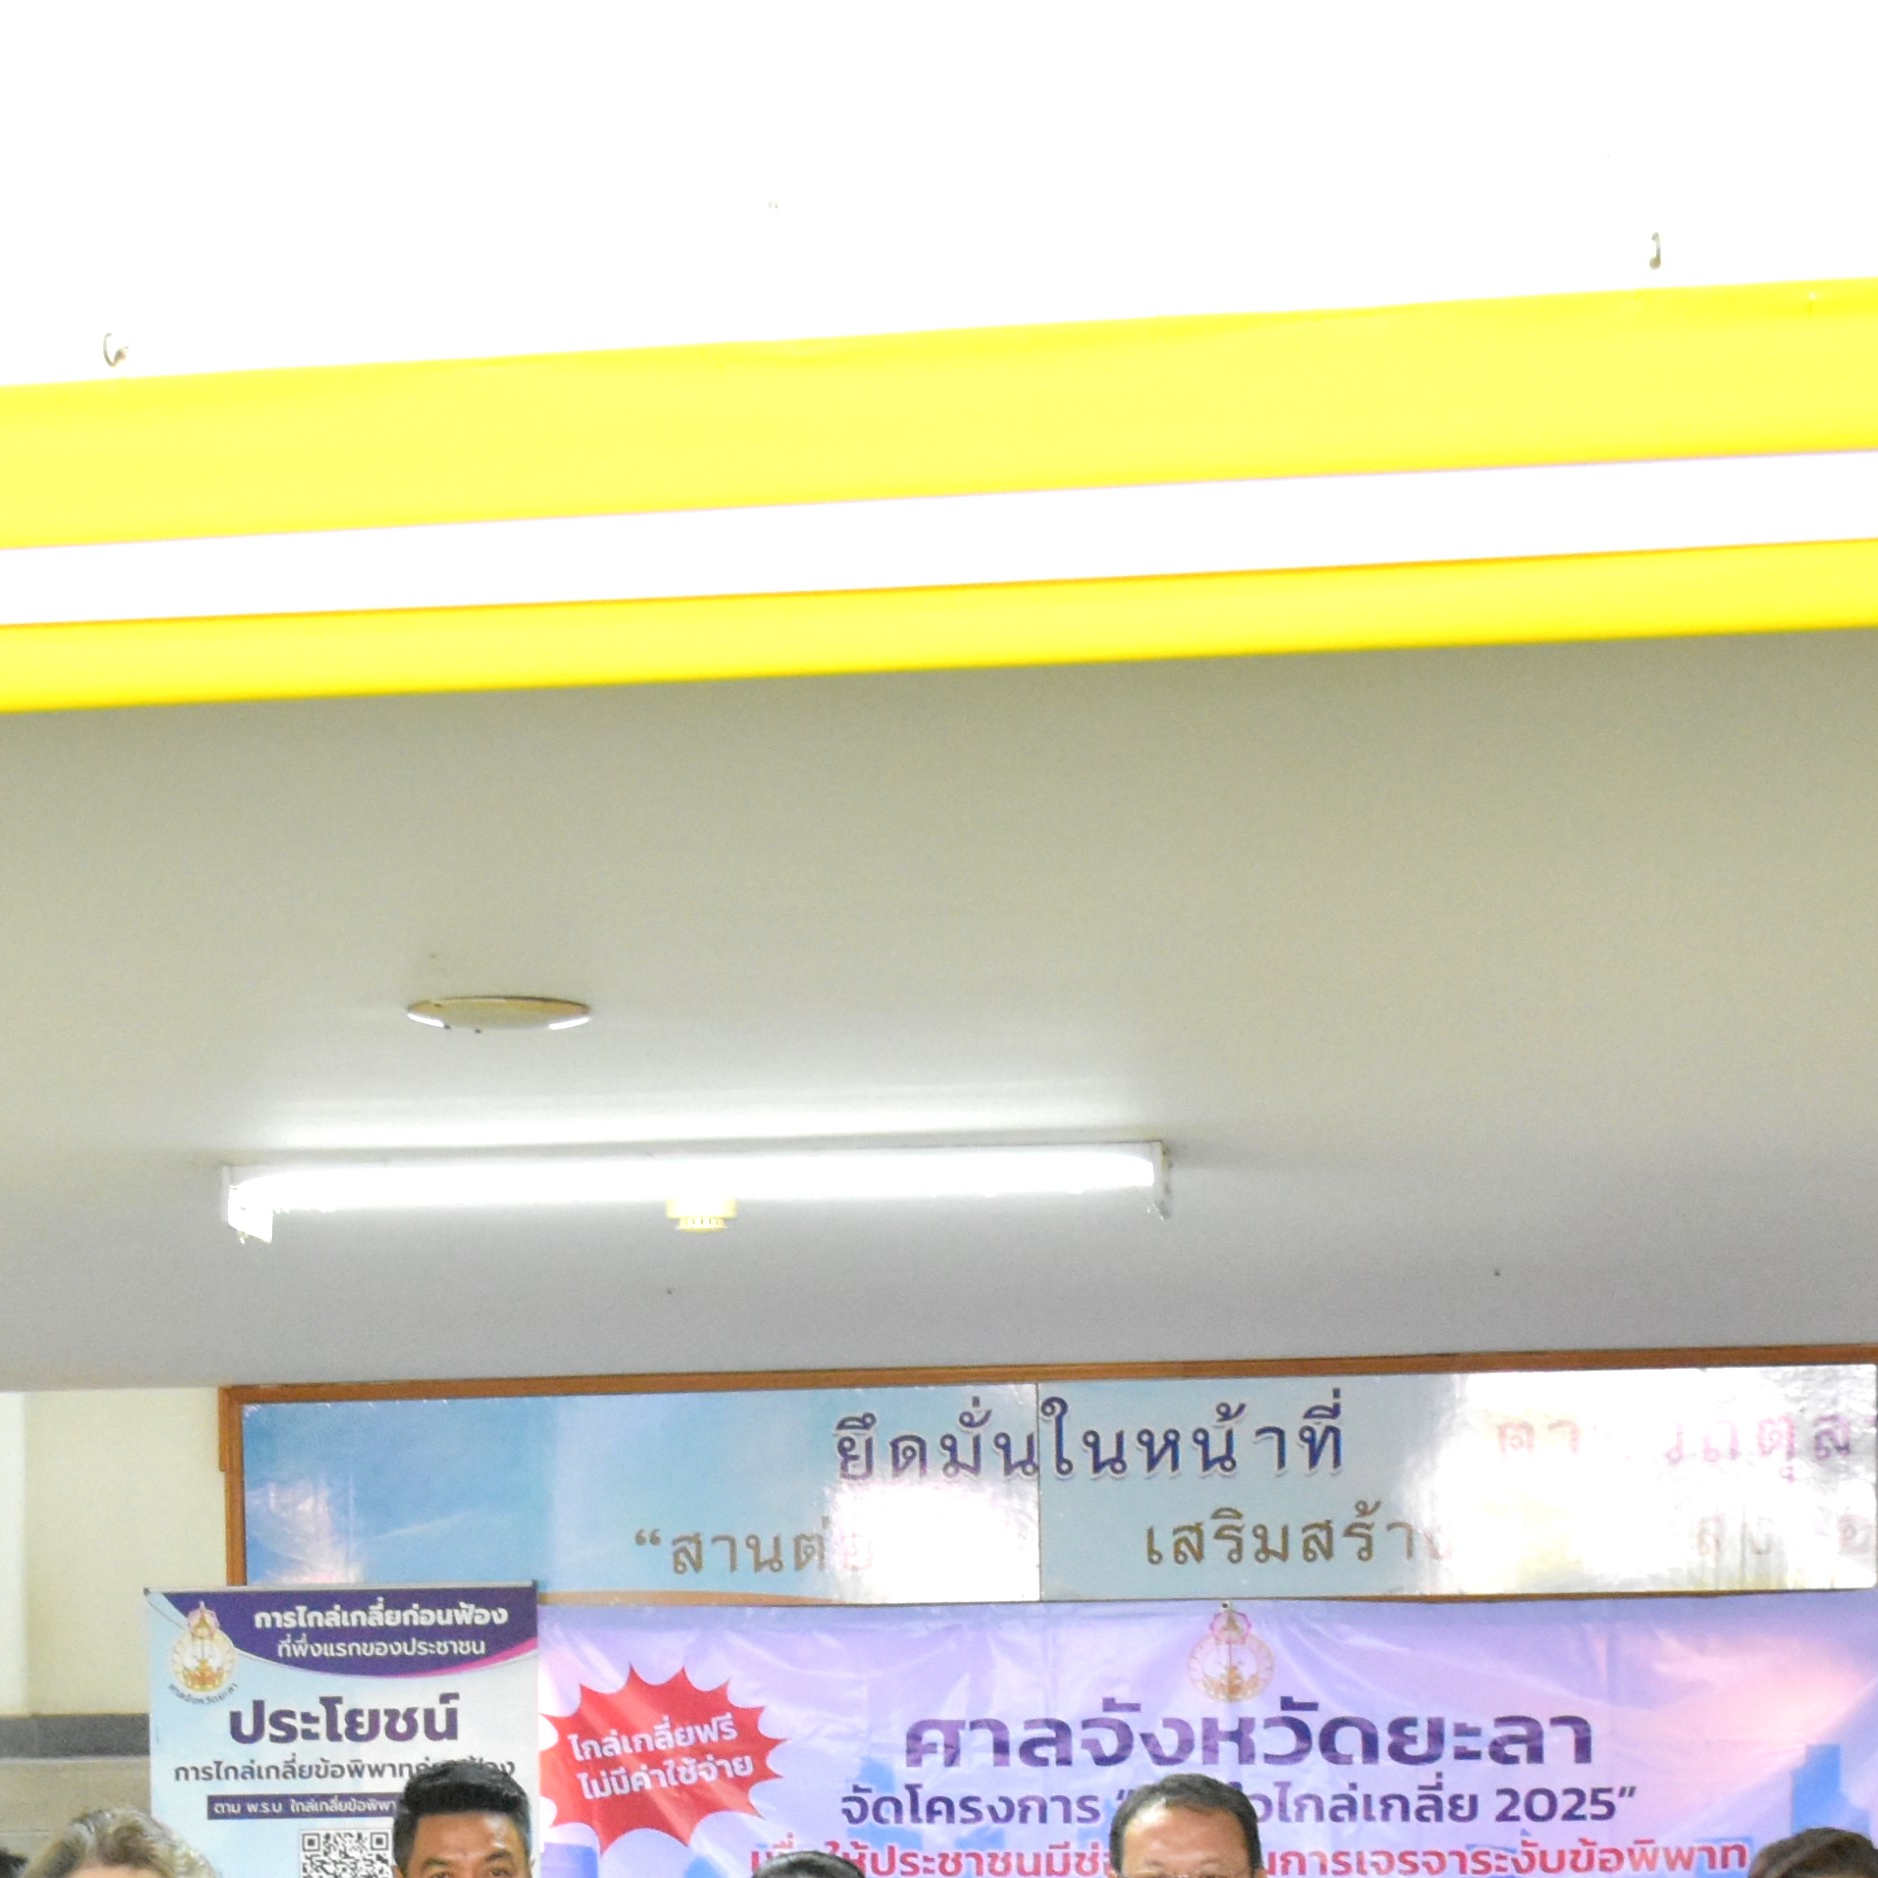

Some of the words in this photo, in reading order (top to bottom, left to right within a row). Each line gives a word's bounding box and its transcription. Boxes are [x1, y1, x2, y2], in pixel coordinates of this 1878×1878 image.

[253, 1596, 509, 1629] การไกล่เกลี่ยก่อนฟ้อง
[277, 1634, 486, 1658] ที่พึ่งแรกของประชาชน
[228, 1692, 462, 1746] ประโยชน์
[567, 1711, 740, 1762] ไกล่เกลี่ยฟรี
[905, 1694, 1593, 1769] ศาลจังหวัดยะลา
[576, 1753, 754, 1801] ไม่มีค่าใช้จ่าย
[213, 1803, 242, 1815] ตาม
[840, 1783, 1102, 1826] จัดโครงการ
